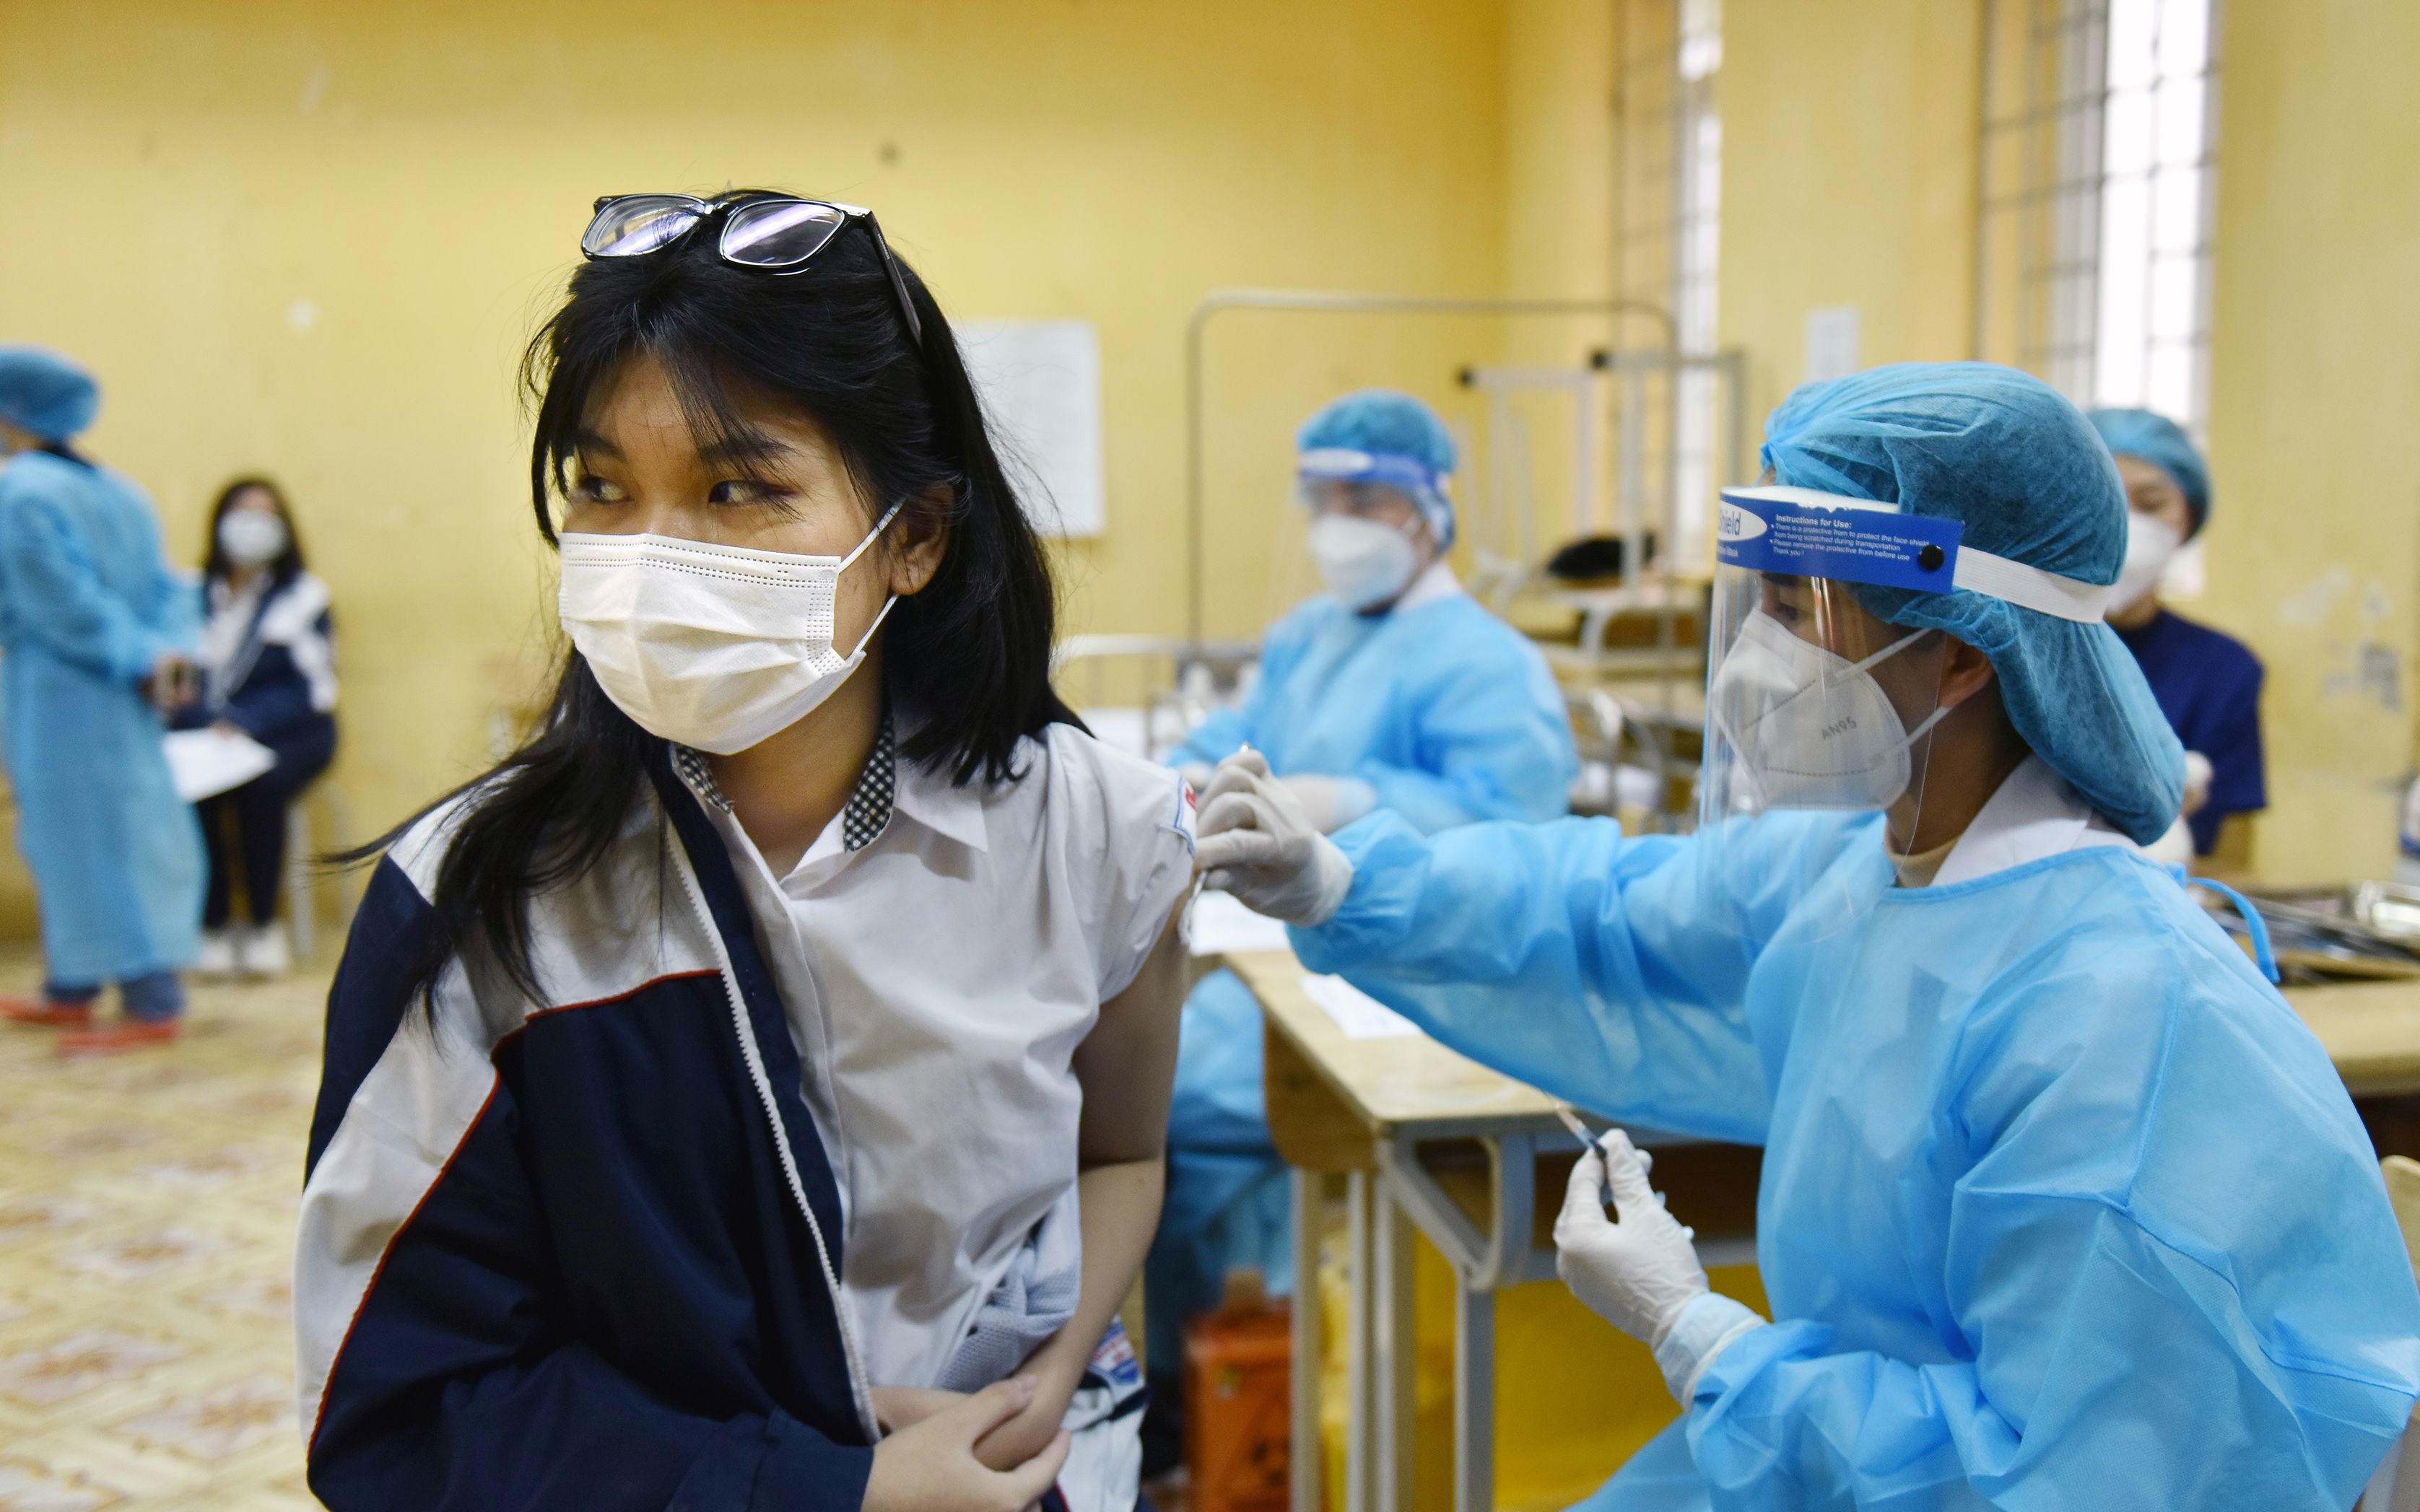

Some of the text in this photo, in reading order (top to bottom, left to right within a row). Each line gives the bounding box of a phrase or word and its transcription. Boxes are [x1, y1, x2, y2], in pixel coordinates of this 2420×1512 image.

[1719, 507, 1741, 536] hield
[1776, 513, 1852, 530] Instructions for Use:
[1773, 546, 1789, 555] Thank
[1788, 533, 1803, 541] being
[1803, 535, 1833, 543] scratched
[1834, 538, 1854, 547] during
[1855, 539, 1900, 551] transportation
[1827, 545, 1857, 554] protective
[1874, 550, 1896, 559] before
